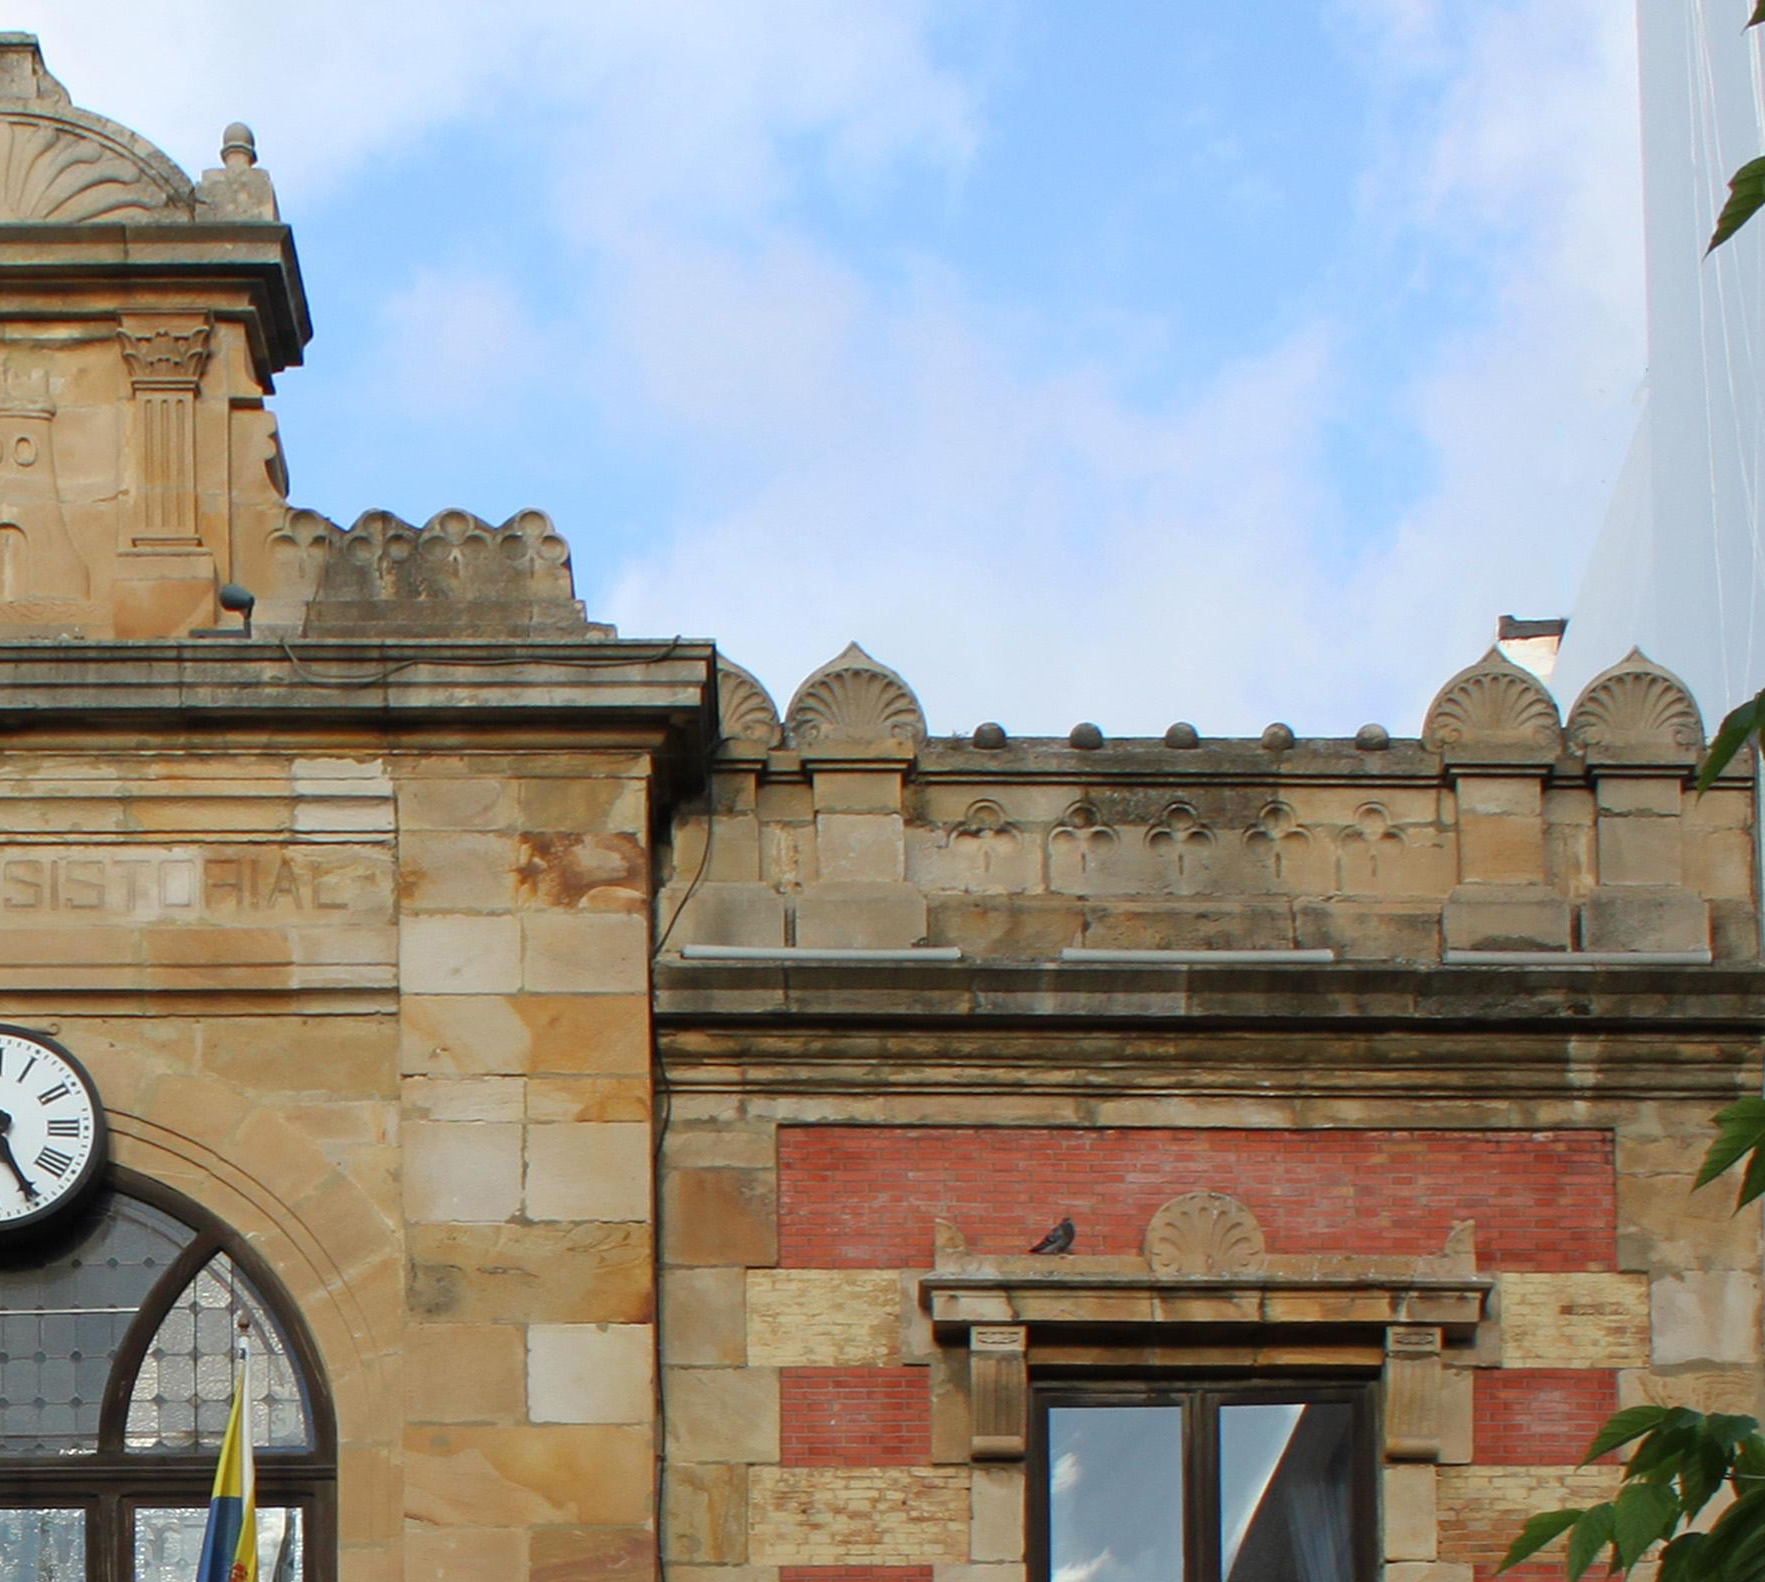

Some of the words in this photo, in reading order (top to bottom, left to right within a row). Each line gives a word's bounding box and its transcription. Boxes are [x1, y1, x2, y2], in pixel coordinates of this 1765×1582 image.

[17, 1057, 38, 1084] I
[37, 1080, 70, 1106] II
[47, 1119, 80, 1138] III
